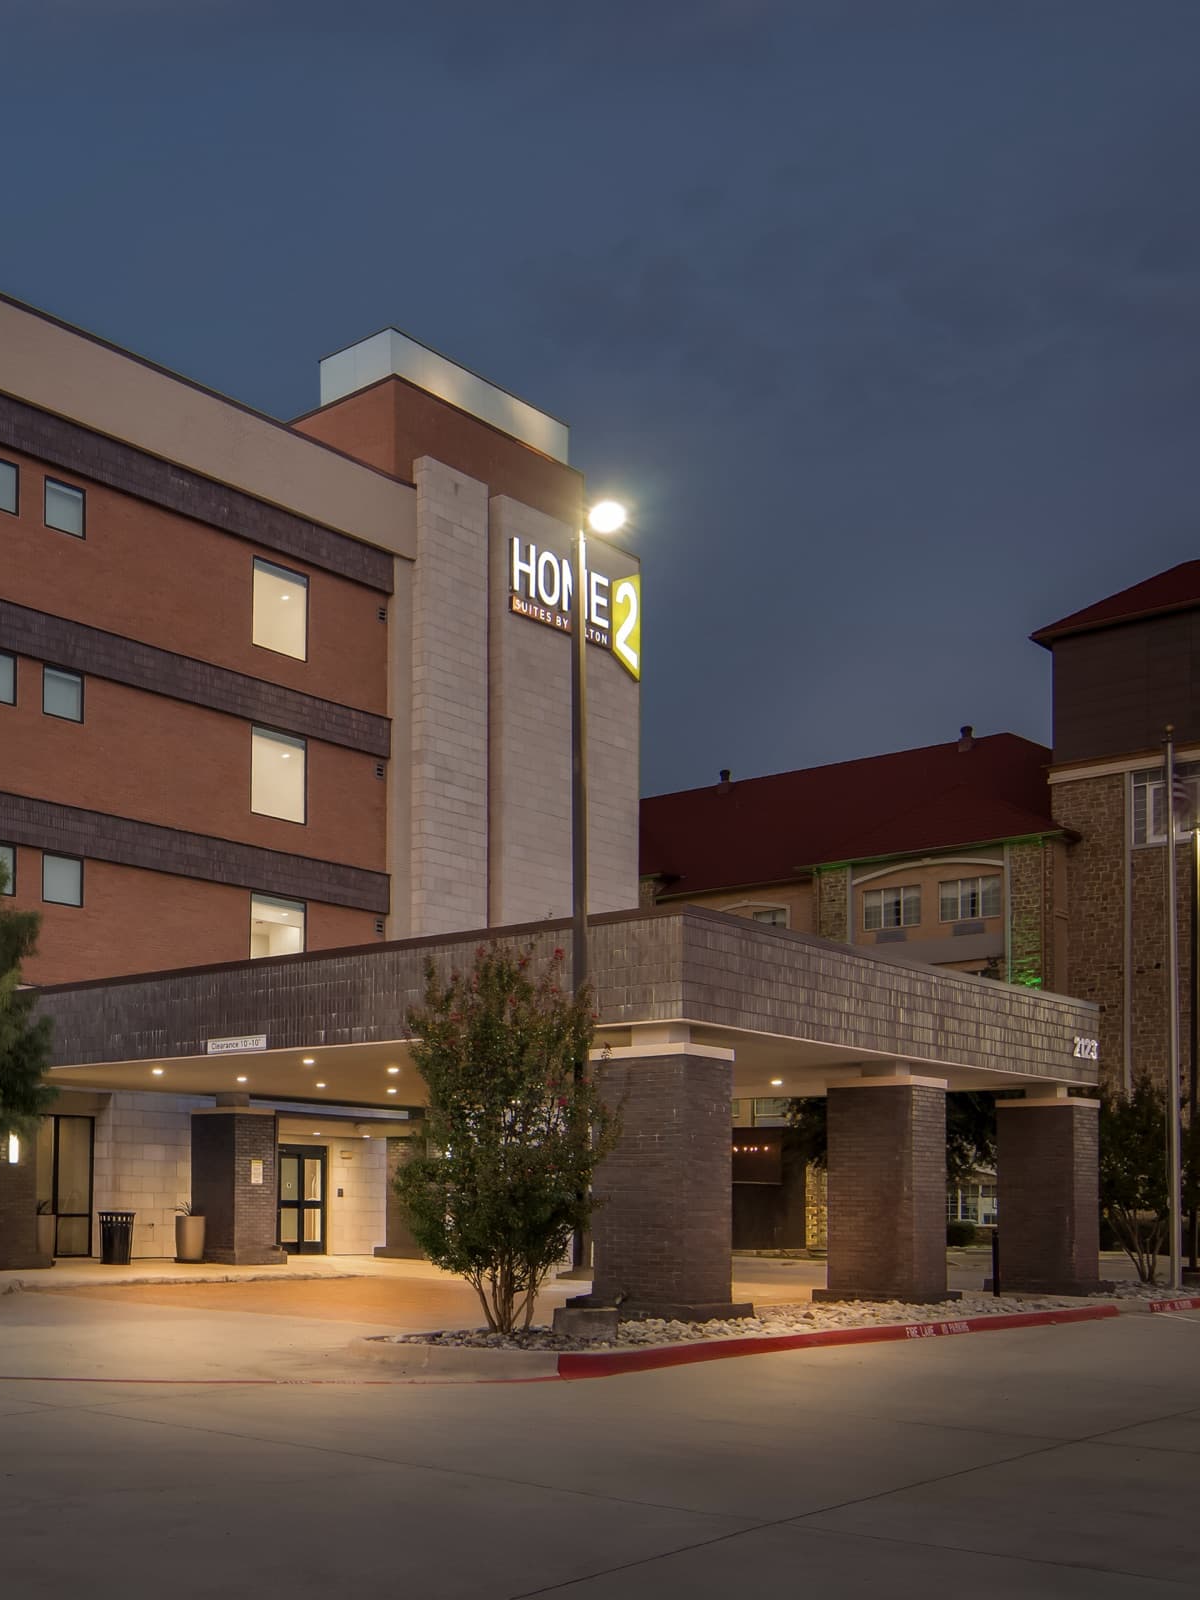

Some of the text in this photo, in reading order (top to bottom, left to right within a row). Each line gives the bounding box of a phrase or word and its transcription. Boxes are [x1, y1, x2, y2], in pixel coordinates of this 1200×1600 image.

[514, 599, 552, 623] SUITES
[556, 615, 569, 629] BY
[615, 581, 638, 670] 2
[211, 1041, 239, 1050] Clearance
